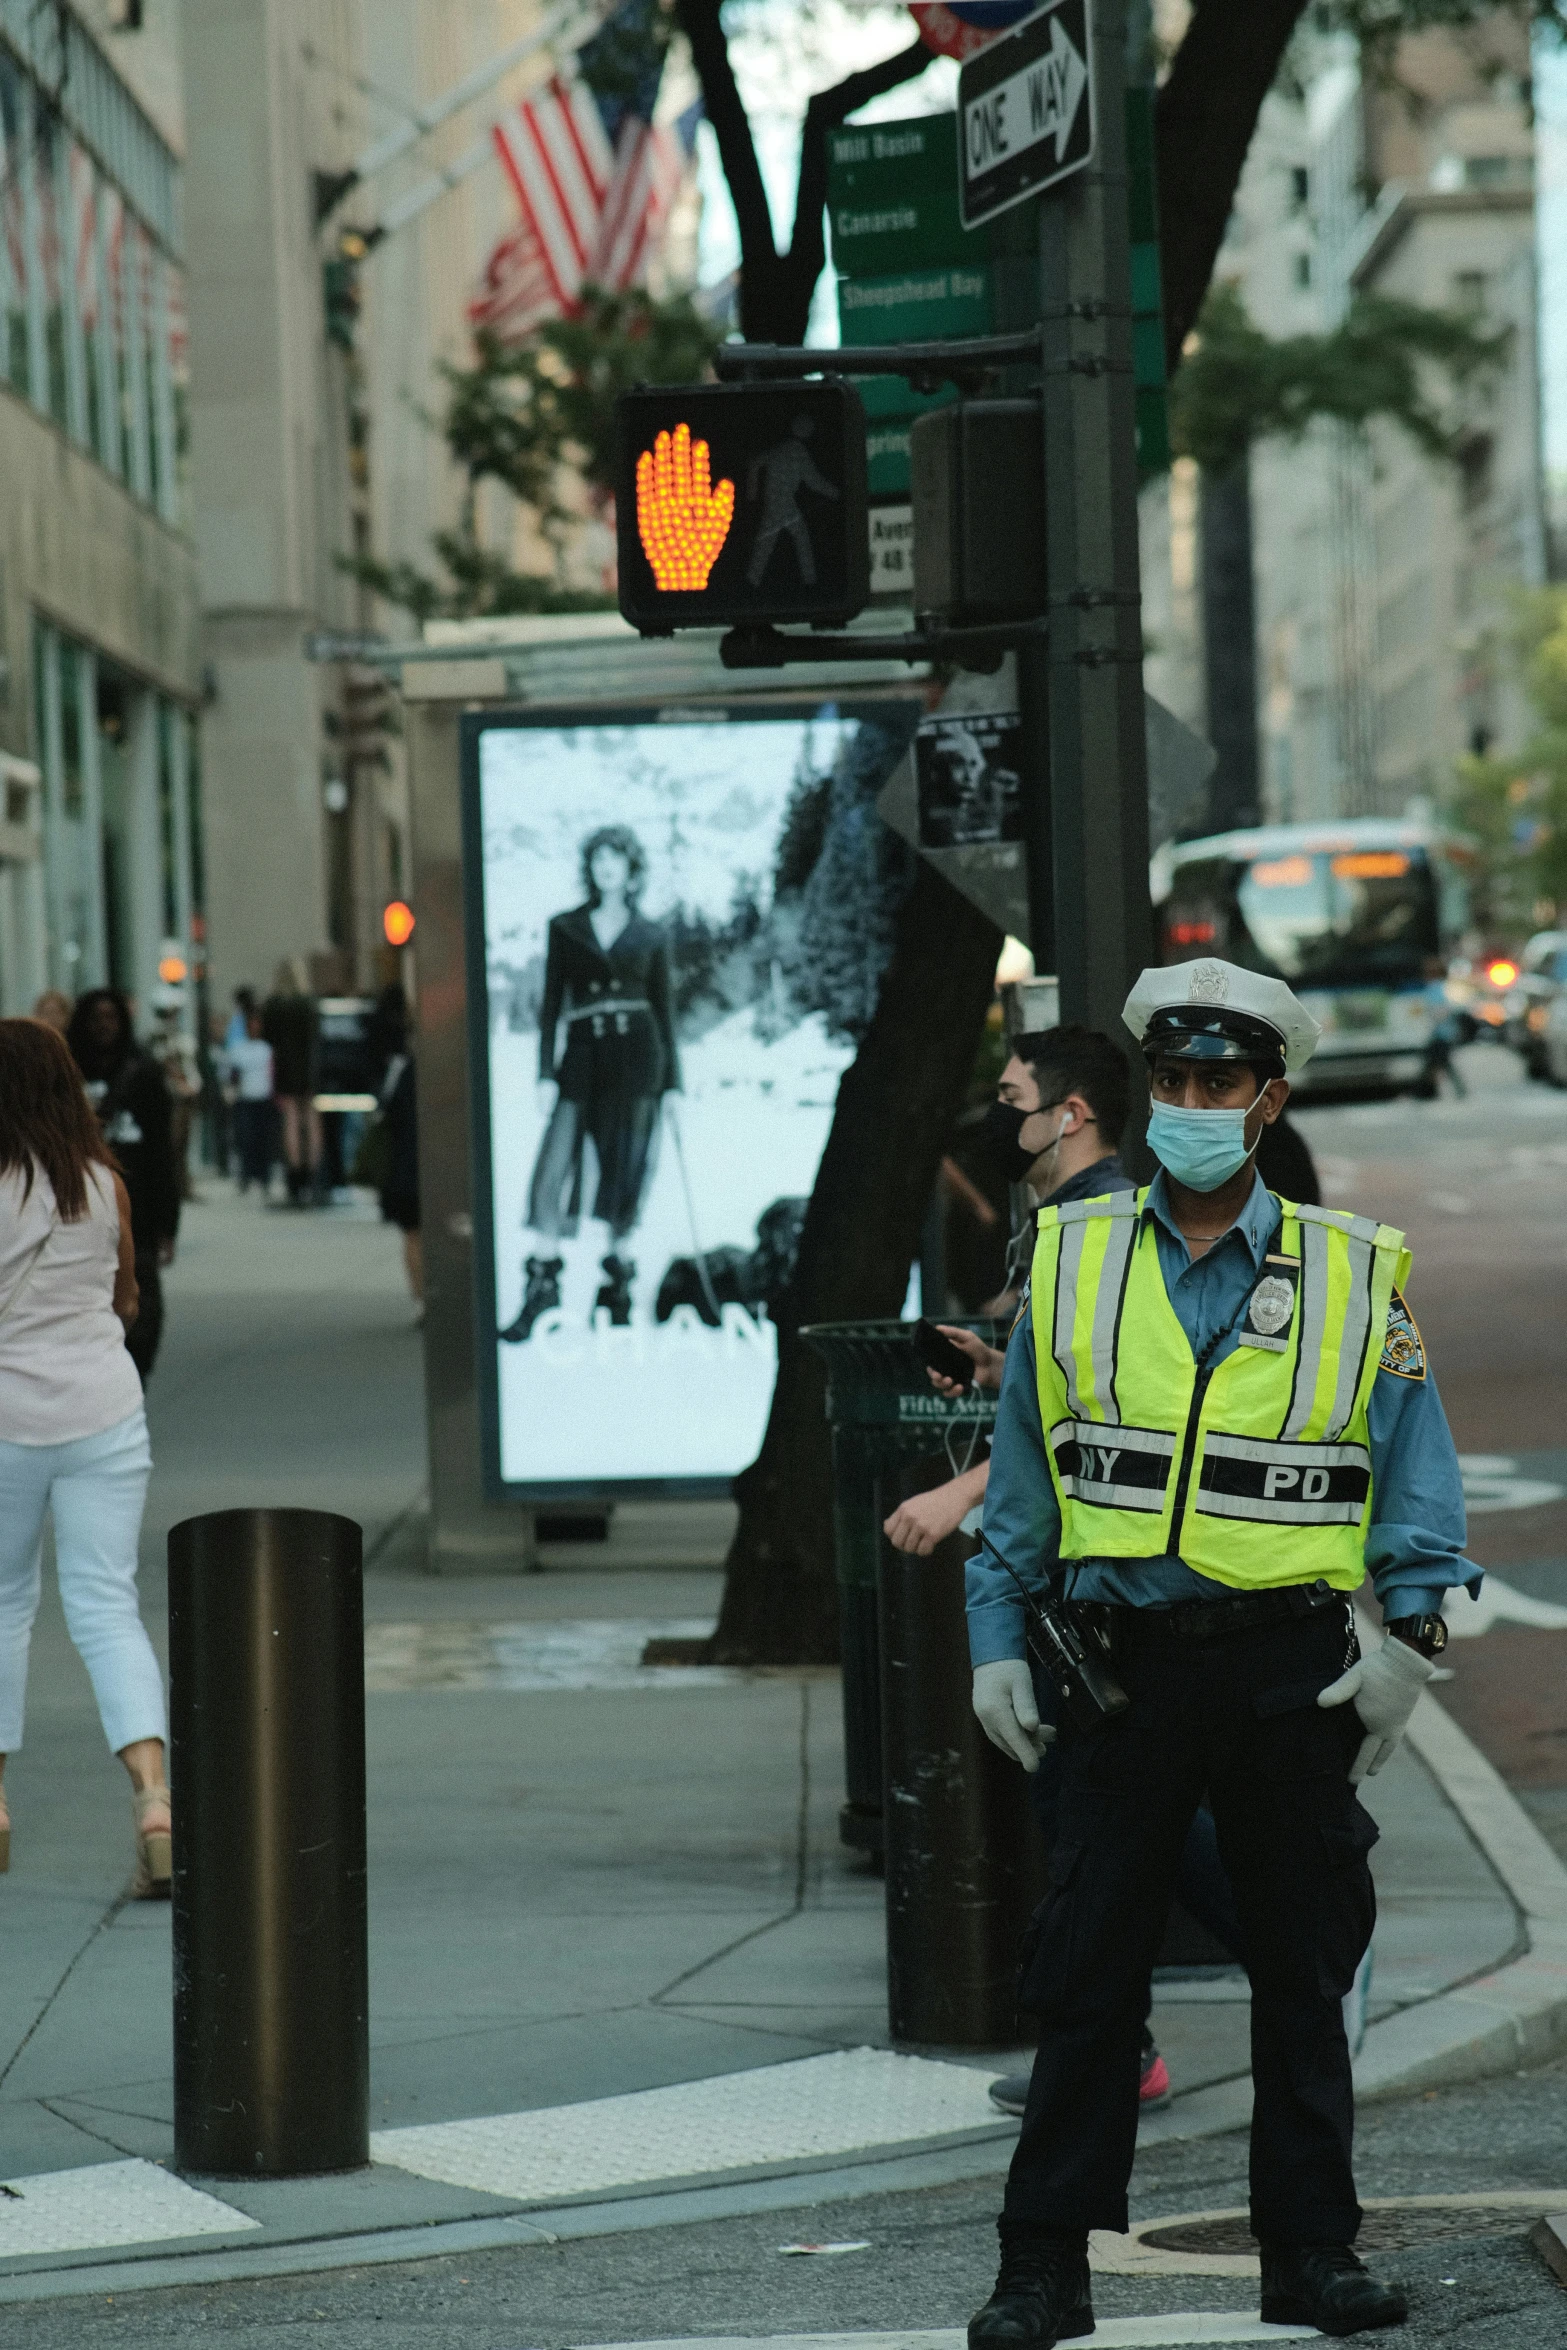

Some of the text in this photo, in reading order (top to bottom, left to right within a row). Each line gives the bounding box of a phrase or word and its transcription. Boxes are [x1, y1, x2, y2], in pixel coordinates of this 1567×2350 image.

[970, 49, 1070, 167] ONE WAY
[834, 138, 869, 163] Mill
[837, 209, 917, 236] Canarsie
[951, 273, 984, 299] Bay
[1250, 1336, 1275, 1348] ULLAH
[899, 1395, 947, 1414] Fifth
[1078, 1445, 1331, 1500] NY PD
